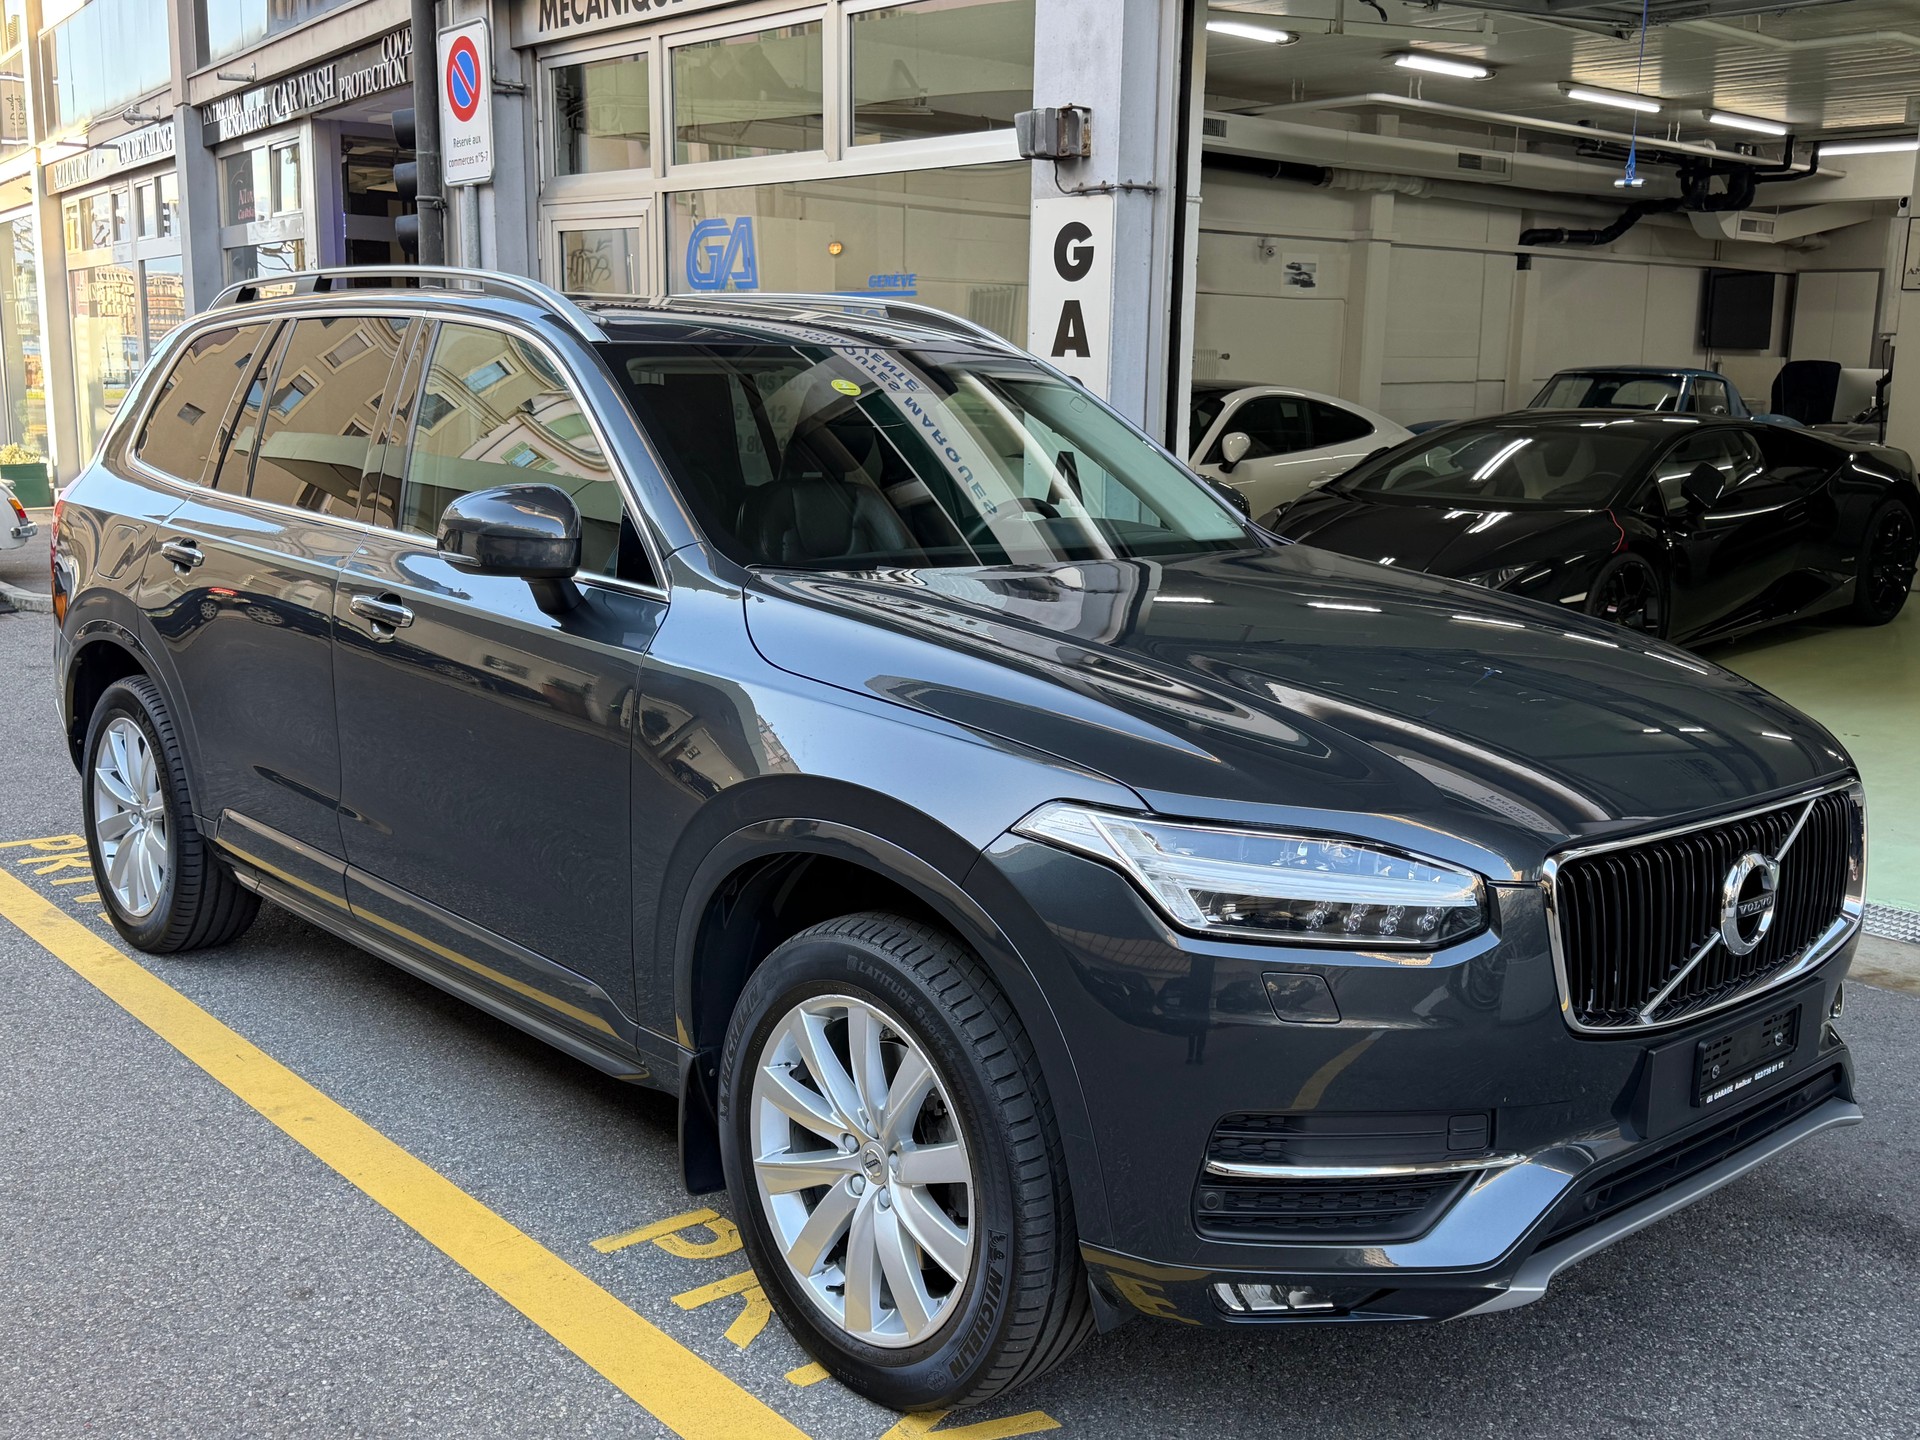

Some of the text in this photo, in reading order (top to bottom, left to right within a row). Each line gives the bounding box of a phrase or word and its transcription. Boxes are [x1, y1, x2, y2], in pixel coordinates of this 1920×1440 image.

[271, 64, 336, 118] CAR WASH
[338, 56, 408, 103] PROTECTION
[686, 216, 759, 290] GA
[1738, 895, 1773, 915] VOLVO
[858, 961, 916, 1007] LATITUDE
[1713, 1084, 1733, 1100] GARAGE
[949, 1264, 1004, 1380] MICHELIN
